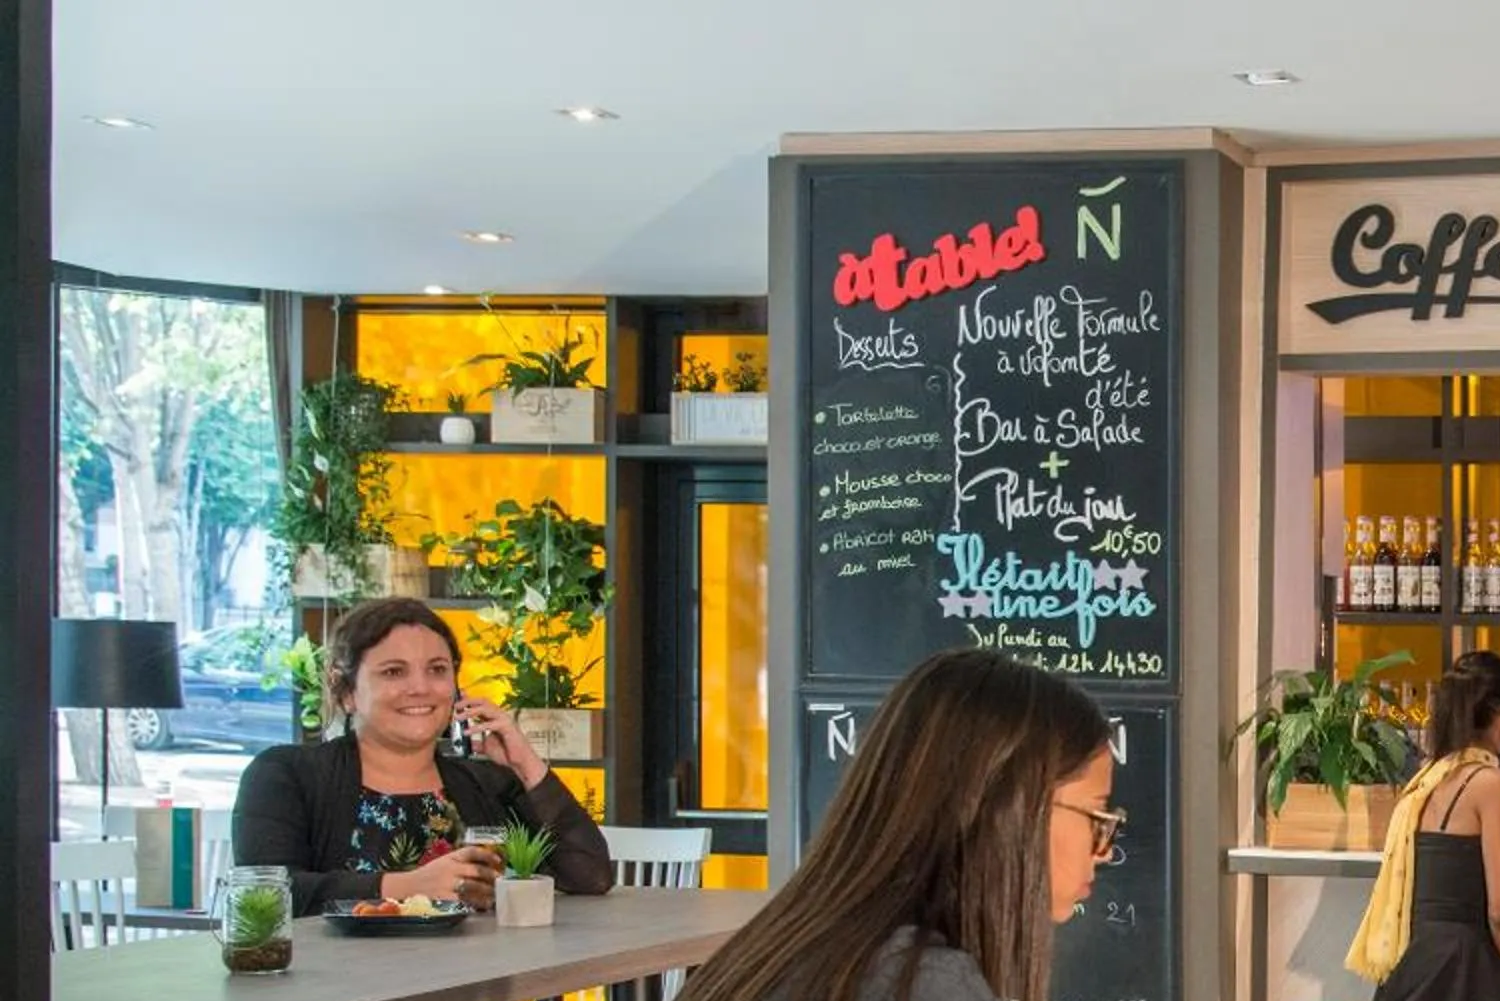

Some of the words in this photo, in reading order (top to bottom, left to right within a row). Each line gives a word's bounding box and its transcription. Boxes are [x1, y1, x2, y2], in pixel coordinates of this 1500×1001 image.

[958, 285, 1067, 346] Nouvelle
[1060, 286, 1161, 340] Formule
[1034, 414, 1051, 444] à
[1056, 408, 1145, 452] Salade
